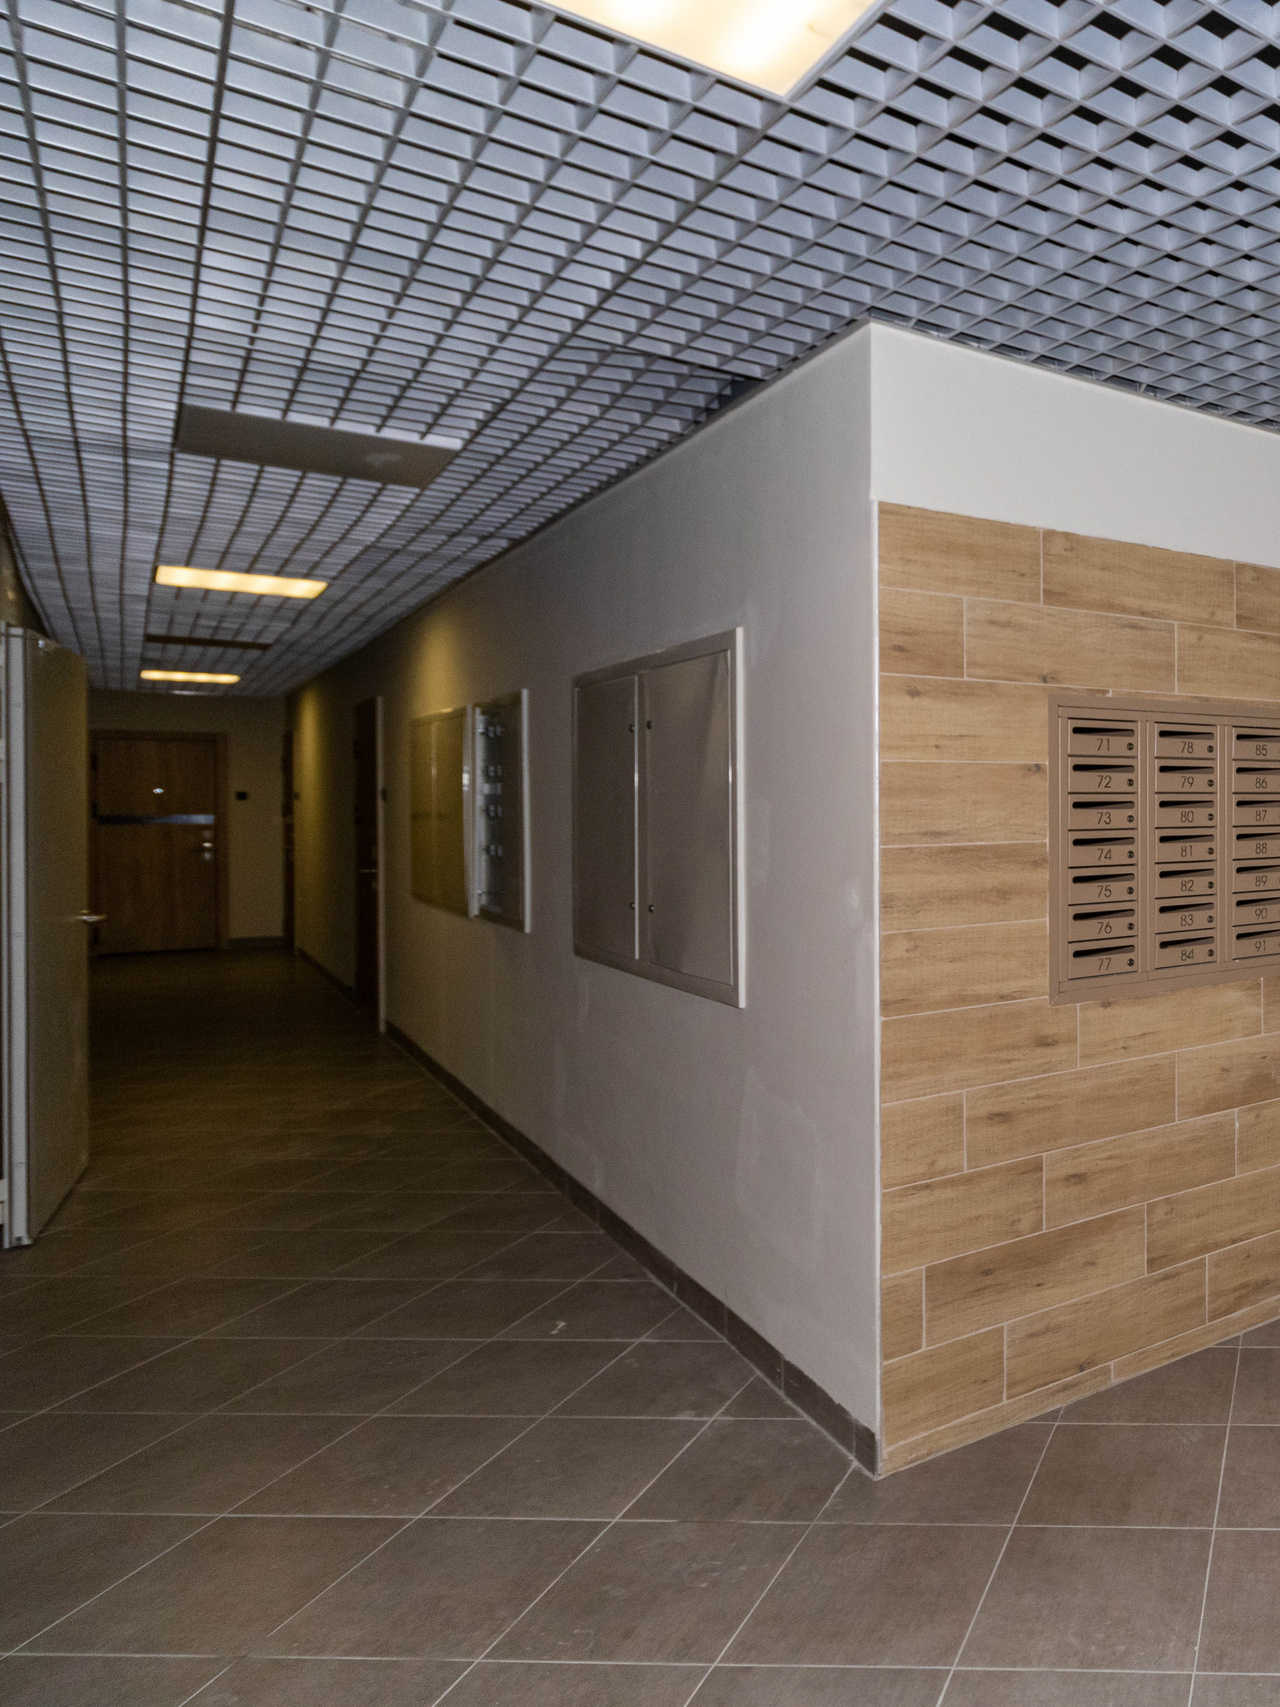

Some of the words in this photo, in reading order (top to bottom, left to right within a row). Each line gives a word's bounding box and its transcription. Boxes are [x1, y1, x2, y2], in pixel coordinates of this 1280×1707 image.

[1097, 738, 1110, 751] 71
[1181, 742, 1194, 753] 78
[1255, 744, 1267, 756] 85
[1097, 775, 1111, 788] 72
[1181, 776, 1194, 788] 79
[1255, 778, 1267, 789] 86
[1097, 812, 1111, 824] 73
[1180, 811, 1194, 823] 80
[1255, 810, 1267, 822] 87
[1097, 848, 1112, 861] 74
[1181, 845, 1193, 857] 81
[1255, 843, 1267, 854] 88
[1181, 880, 1194, 892] 82
[1255, 875, 1267, 886] 89
[1097, 885, 1112, 898] 75
[1255, 908, 1267, 919] 90
[1181, 914, 1193, 926] 83
[1097, 922, 1112, 934] 76
[1255, 940, 1266, 952] 91
[1181, 949, 1194, 961] 84
[1098, 958, 1112, 971] 77
